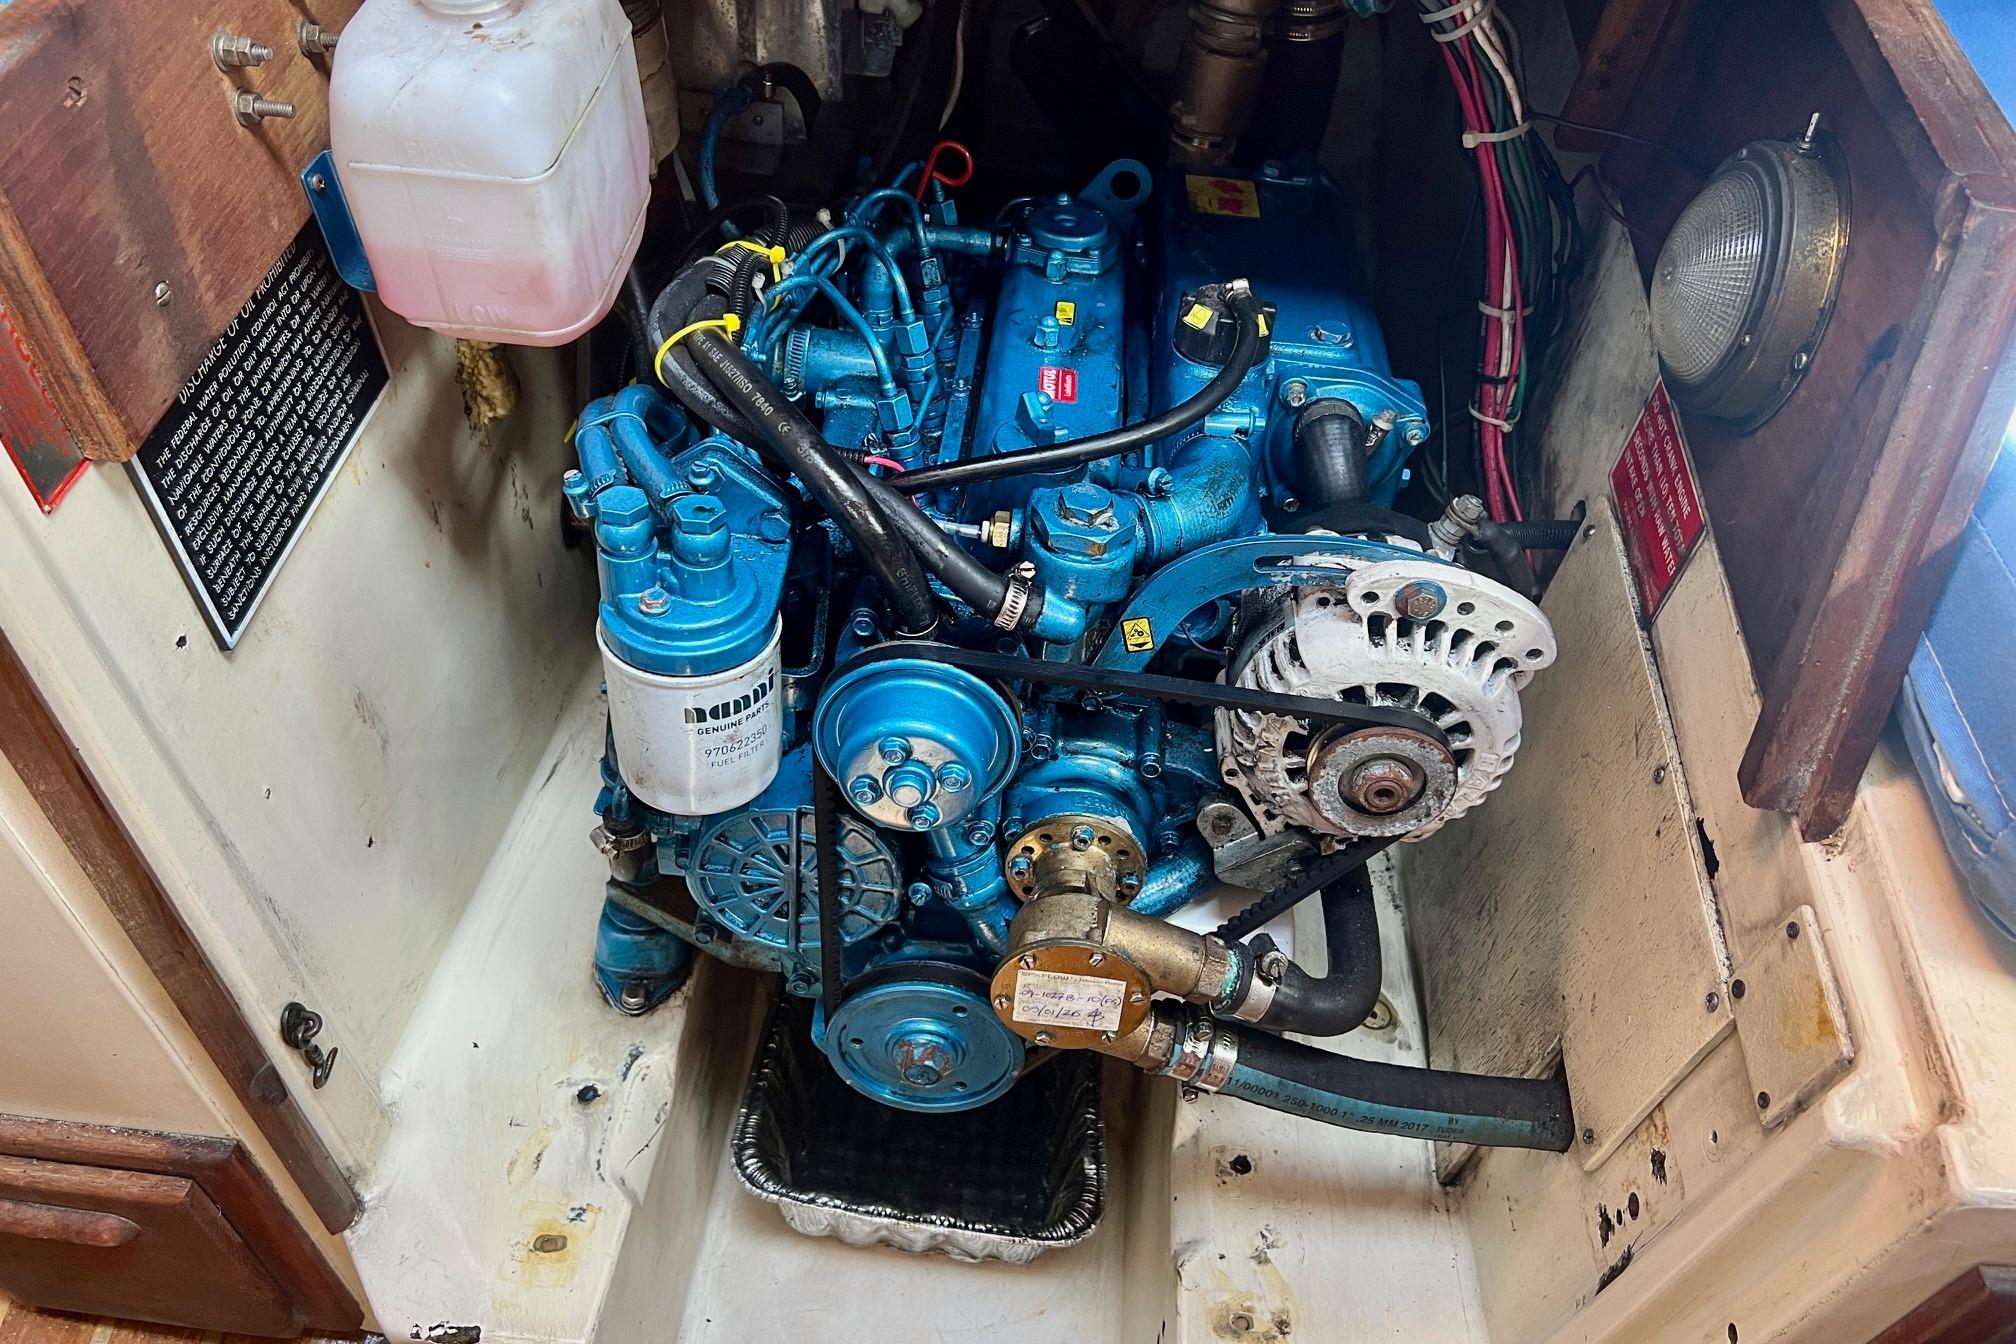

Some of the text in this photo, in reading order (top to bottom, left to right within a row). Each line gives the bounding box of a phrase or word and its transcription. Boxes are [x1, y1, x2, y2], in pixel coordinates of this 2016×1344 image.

[156, 447, 171, 468] THE
[171, 412, 197, 448] FEDERAL
[196, 381, 218, 410] WATER
[218, 335, 250, 382] POLLUTION
[251, 299, 277, 336] CONTROL
[278, 281, 288, 300] ACT
[161, 468, 176, 488] THE
[175, 417, 211, 469] DISCHARGE
[211, 401, 221, 417] OF
[221, 386, 233, 402] OIL
[233, 370, 244, 386] OR
[243, 350, 257, 371] OILY
[256, 324, 277, 352] WASTE
[276, 304, 291, 326] INTO
[290, 290, 300, 304] OR
[300, 267, 316, 291] UPON
[168, 454, 204, 505] NAVIGABLE
[203, 419, 228, 453] WATERS
[227, 404, 237, 419] OF
[237, 385, 251, 404] THE
[250, 356, 271, 387] UNITED
[290, 314, 300, 329] OR
[300, 298, 311, 315] THE
[177, 503, 187, 519] OF
[188, 483, 202, 503] THE
[201, 424, 242, 483] CONTIGUOUS
[260, 381, 271, 396] OR
[270, 351, 291, 381] WHICH
[291, 333, 303, 354] MAY
[304, 307, 321, 335] AFFECT
[185, 482, 220, 535] RESOURCES
[220, 430, 255, 482] BELONGING
[267, 358, 303, 414] APPERTAINING
[311, 330, 322, 344] OR
[192, 503, 223, 550] EXCLUSIVE
[223, 440, 263, 503] MANAGEMENT
[265, 395, 293, 441] AUTHORITY
[292, 381, 302, 396] OF
[301, 365, 313, 382] THE
[312, 338, 331, 366] UNITED
[708, 347, 722, 362] SAE
[719, 360, 752, 394] J1527/ISO
[751, 392, 774, 416] 7840
[199, 553, 206, 565] IF
[206, 525, 225, 553] SUCH
[224, 476, 257, 526] DISCHARGE
[256, 442, 279, 475] CAUSES
[279, 434, 285, 444] A
[284, 413, 297, 434] FILM
[296, 400, 306, 414] OR
[305, 341, 344, 400] DISCOLORATION
[206, 539, 232, 578] SURFACE
[231, 522, 241, 538] OF
[242, 503, 255, 522] THE
[253, 475, 273, 503] WATER
[272, 460, 283, 475] OR
[282, 428, 303, 460] CAUSES
[303, 420, 309, 429] A
[308, 389, 328, 420] SLUDGE
[327, 376, 336, 389] OR
[213, 550, 240, 593] BENEATH
[240, 531, 253, 549] THE
[252, 494, 276, 531] SURFACE
[275, 479, 284, 494] OF
[284, 461, 297, 479] THE
[316, 389, 342, 429] VIOLATORS
[341, 374, 352, 391] ARE
[221, 566, 245, 606] SUBJECT
[245, 551, 255, 565] TO
[255, 498, 289, 550] SUBSTANTIAL
[288, 476, 302, 497] CIVIL
[327, 403, 347, 436] AND/OR
[1633, 430, 1649, 481] SECONDS
[1646, 478, 1658, 511] WITH
[1654, 508, 1665, 536] RAW
[1634, 487, 1645, 517] OPEN
[1651, 442, 1663, 476] THAN
[1666, 495, 1676, 522] TEN
[1663, 435, 1678, 476] CRANK
[1674, 474, 1690, 519] ENGINE
[228, 566, 261, 619] SANCTIONS
[260, 517, 291, 565] INCLUDING
[290, 491, 307, 517] FINES
[307, 472, 318, 492] AND
[684, 668, 774, 723] nanni
[698, 700, 770, 736] GENUINE PARTS
[704, 724, 768, 758] 970622350
[711, 741, 765, 768] FUEL FILTER
[1376, 1117, 1398, 1128] MM
[1400, 1121, 1430, 1132] 2017
